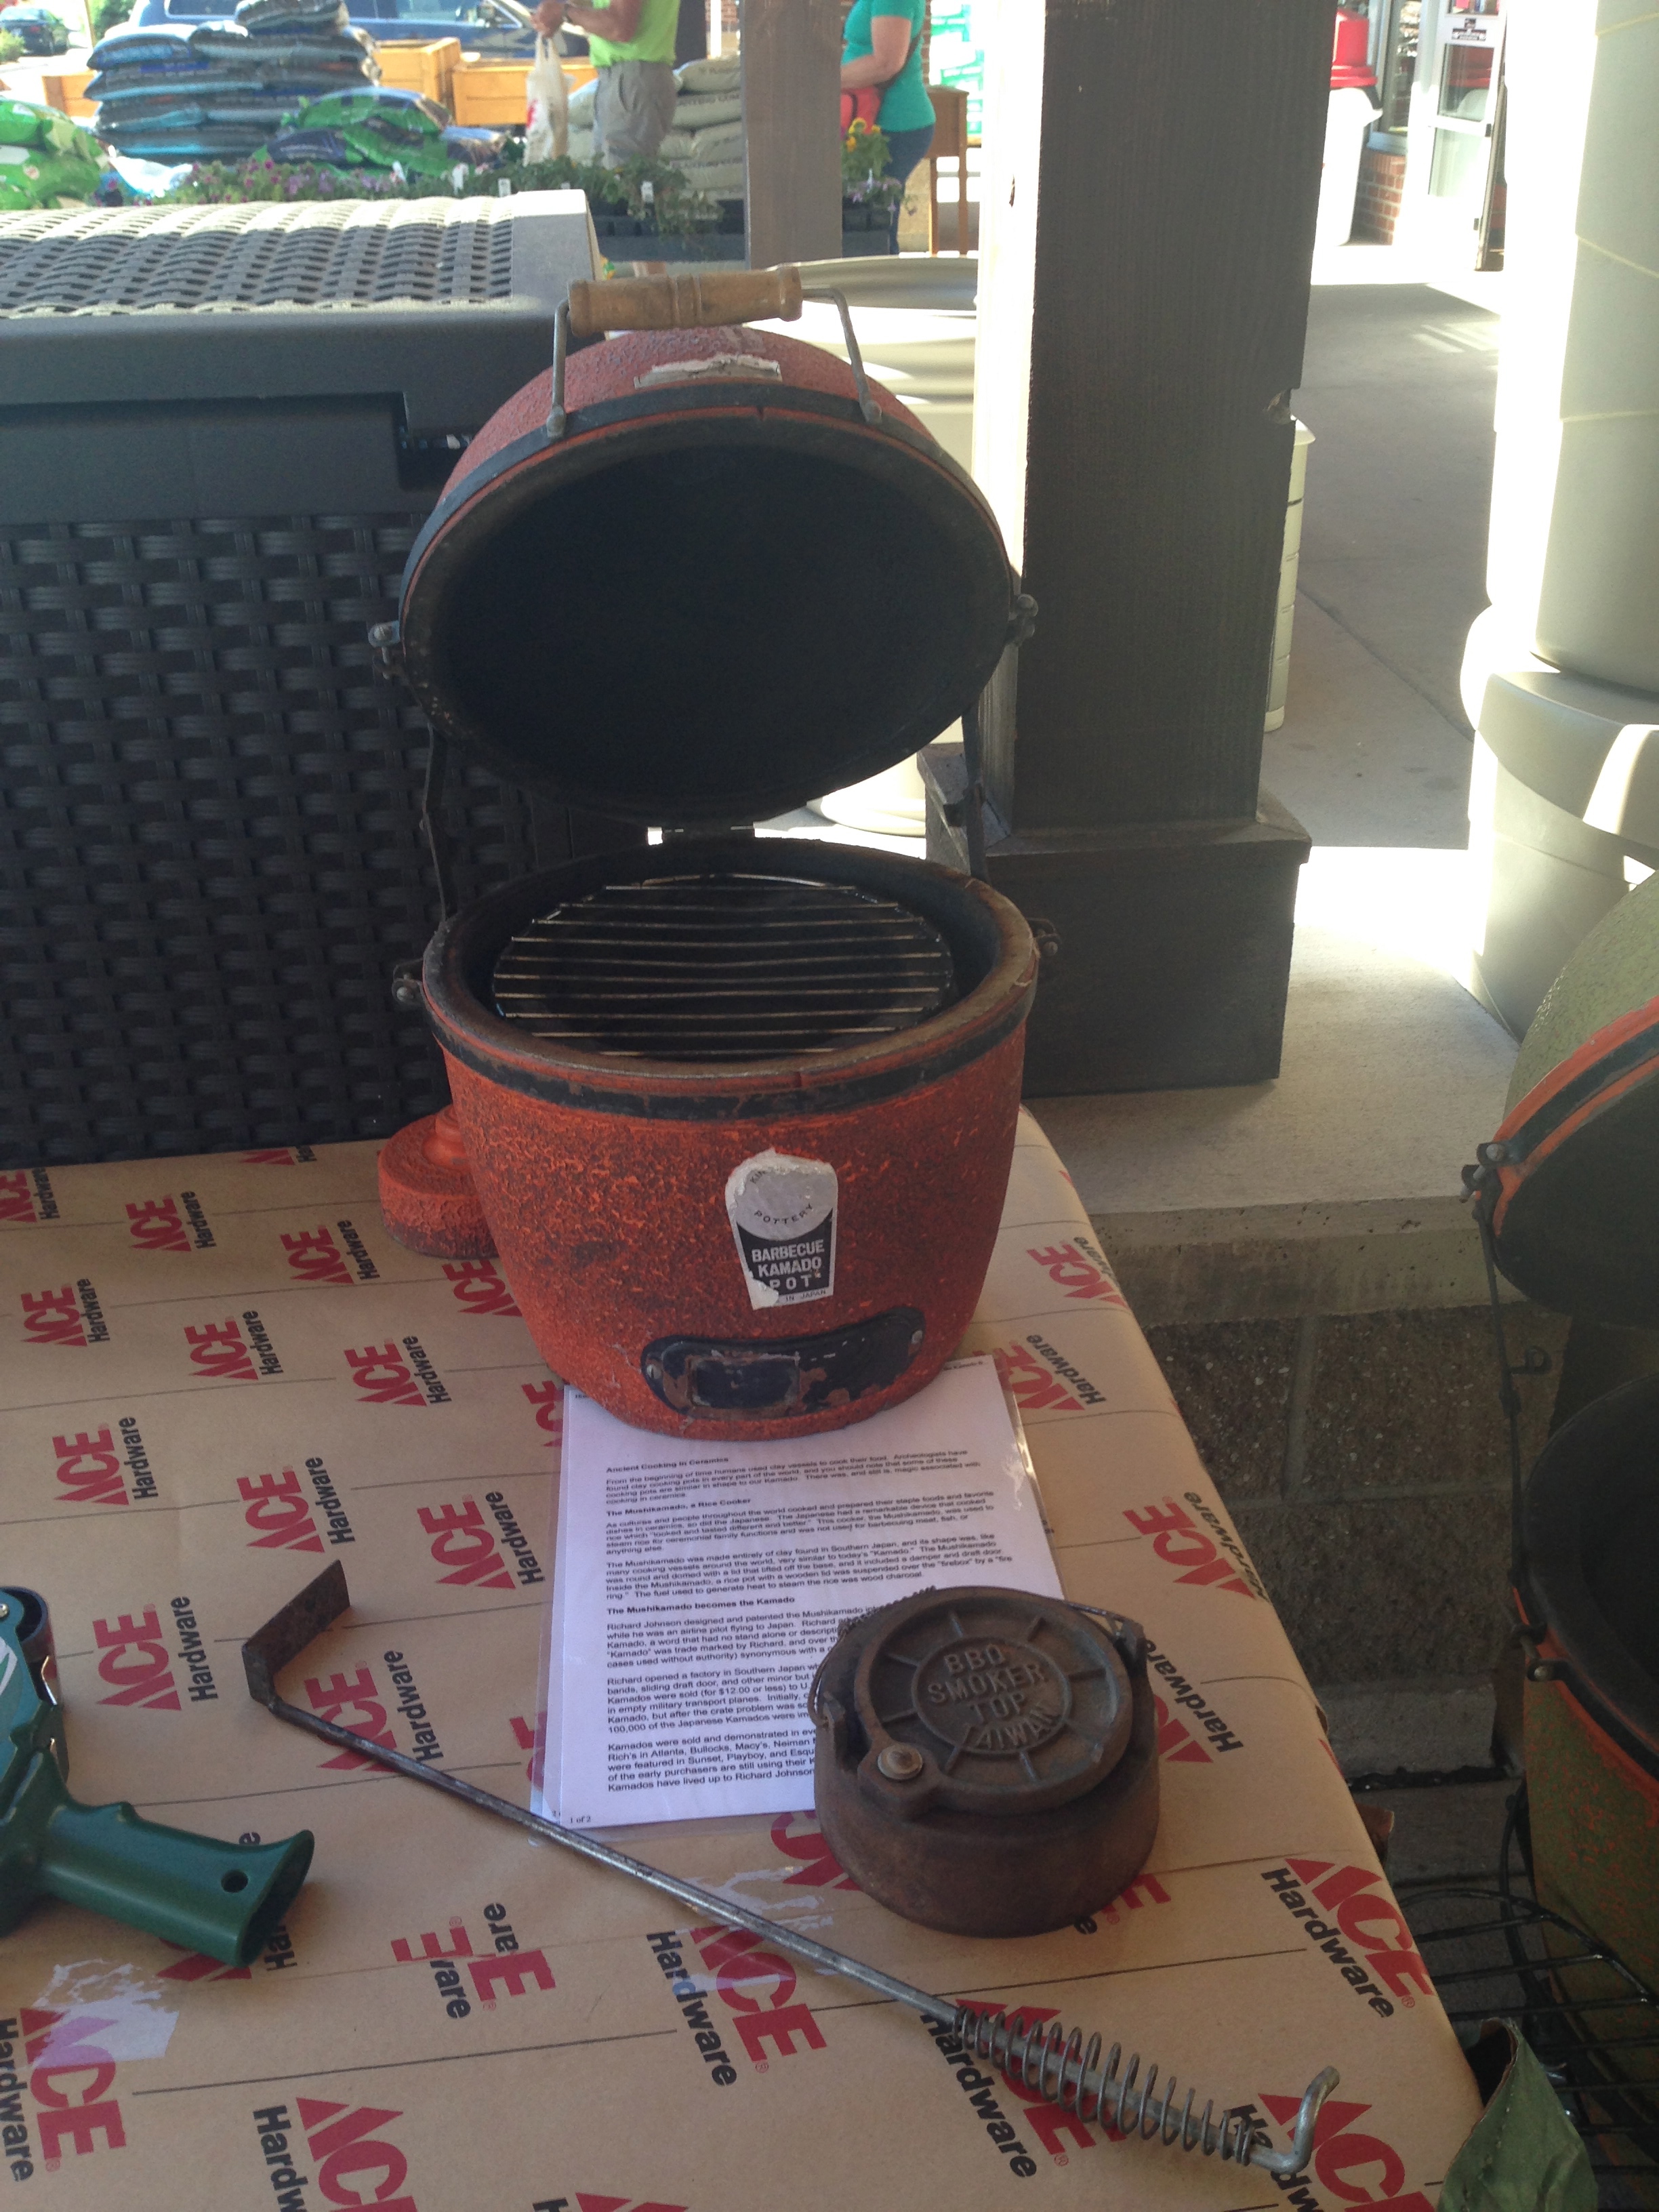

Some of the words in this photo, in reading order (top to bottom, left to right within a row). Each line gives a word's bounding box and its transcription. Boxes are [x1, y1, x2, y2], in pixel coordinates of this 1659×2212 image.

[126, 1197, 190, 1252] ACE
[181, 1191, 216, 1248] Hardware
[754, 1203, 813, 1225] POTTERY
[281, 1227, 352, 1284] ACE
[337, 1220, 380, 1279] Hardware
[752, 1240, 825, 1263] BARBECUE
[758, 1256, 822, 1277] KAMADO
[769, 1274, 812, 1290] POT
[800, 1289, 826, 1299] JAPAN
[22, 1288, 87, 1346] ACE
[77, 1279, 110, 1343] Hardware
[185, 1321, 258, 1380] ACE
[243, 1311, 283, 1374] Hardware
[403, 1336, 451, 1404] Hardware
[1027, 1335, 1105, 1404] Hardware
[345, 1343, 426, 1406] ACE
[54, 1429, 128, 1505] ACE
[119, 1418, 158, 1499] Hardware
[238, 1471, 324, 1553] ACE
[306, 1458, 355, 1544] Hardware
[417, 1501, 515, 1589] ACE
[486, 1492, 544, 1584] Hardware
[1122, 1502, 1256, 1599] ACE
[626, 1603, 692, 1613] Mushikamado
[756, 1597, 794, 1605] Kamado
[94, 1611, 180, 1710] ACE
[171, 1597, 218, 1702] Hardware
[607, 1676, 642, 1685] Richard
[644, 1673, 679, 1683] opened
[690, 1671, 720, 1682] factory
[734, 1667, 775, 1675] Southern
[777, 1665, 805, 1675] Japan
[384, 1650, 444, 1761] Hardware
[607, 1695, 651, 1704] Kamados
[679, 1690, 697, 1698] sold
[701, 1689, 716, 1697] (for
[718, 1686, 750, 1698] $12.00
[764, 1684, 786, 1695] less)
[618, 1704, 647, 1713] empty
[649, 1702, 682, 1713] military
[684, 1698, 726, 1711] transport
[710, 1706, 733, 1715] crate
[736, 1704, 773, 1714] problem
[927, 1663, 1045, 1703] SMOKER
[967, 1693, 1025, 1722] TOP
[608, 1723, 646, 1733] 100,000
[678, 1718, 723, 1727] Japanese
[725, 1715, 770, 1723] Kamados
[608, 1742, 653, 1750] Kamados
[681, 1736, 701, 1744] sold
[703, 1735, 721, 1743] and
[724, 1730, 788, 1741] demonstrated
[961, 1704, 1054, 1749] TAIWAN
[608, 1753, 637, 1761] Rich's
[608, 1782, 653, 1791] Kamados
[683, 1776, 705, 1784] lived
[735, 1771, 772, 1780] Richard
[634, 1759, 674, 1769] featured
[638, 1770, 661, 1778] early
[664, 1766, 717, 1777] purchasers
[739, 1761, 754, 1769] still
[757, 1761, 783, 1769] using
[1261, 1868, 1395, 2018] Hardware
[20, 2008, 127, 2159] ACE
[253, 2105, 309, 2212] Hardw
